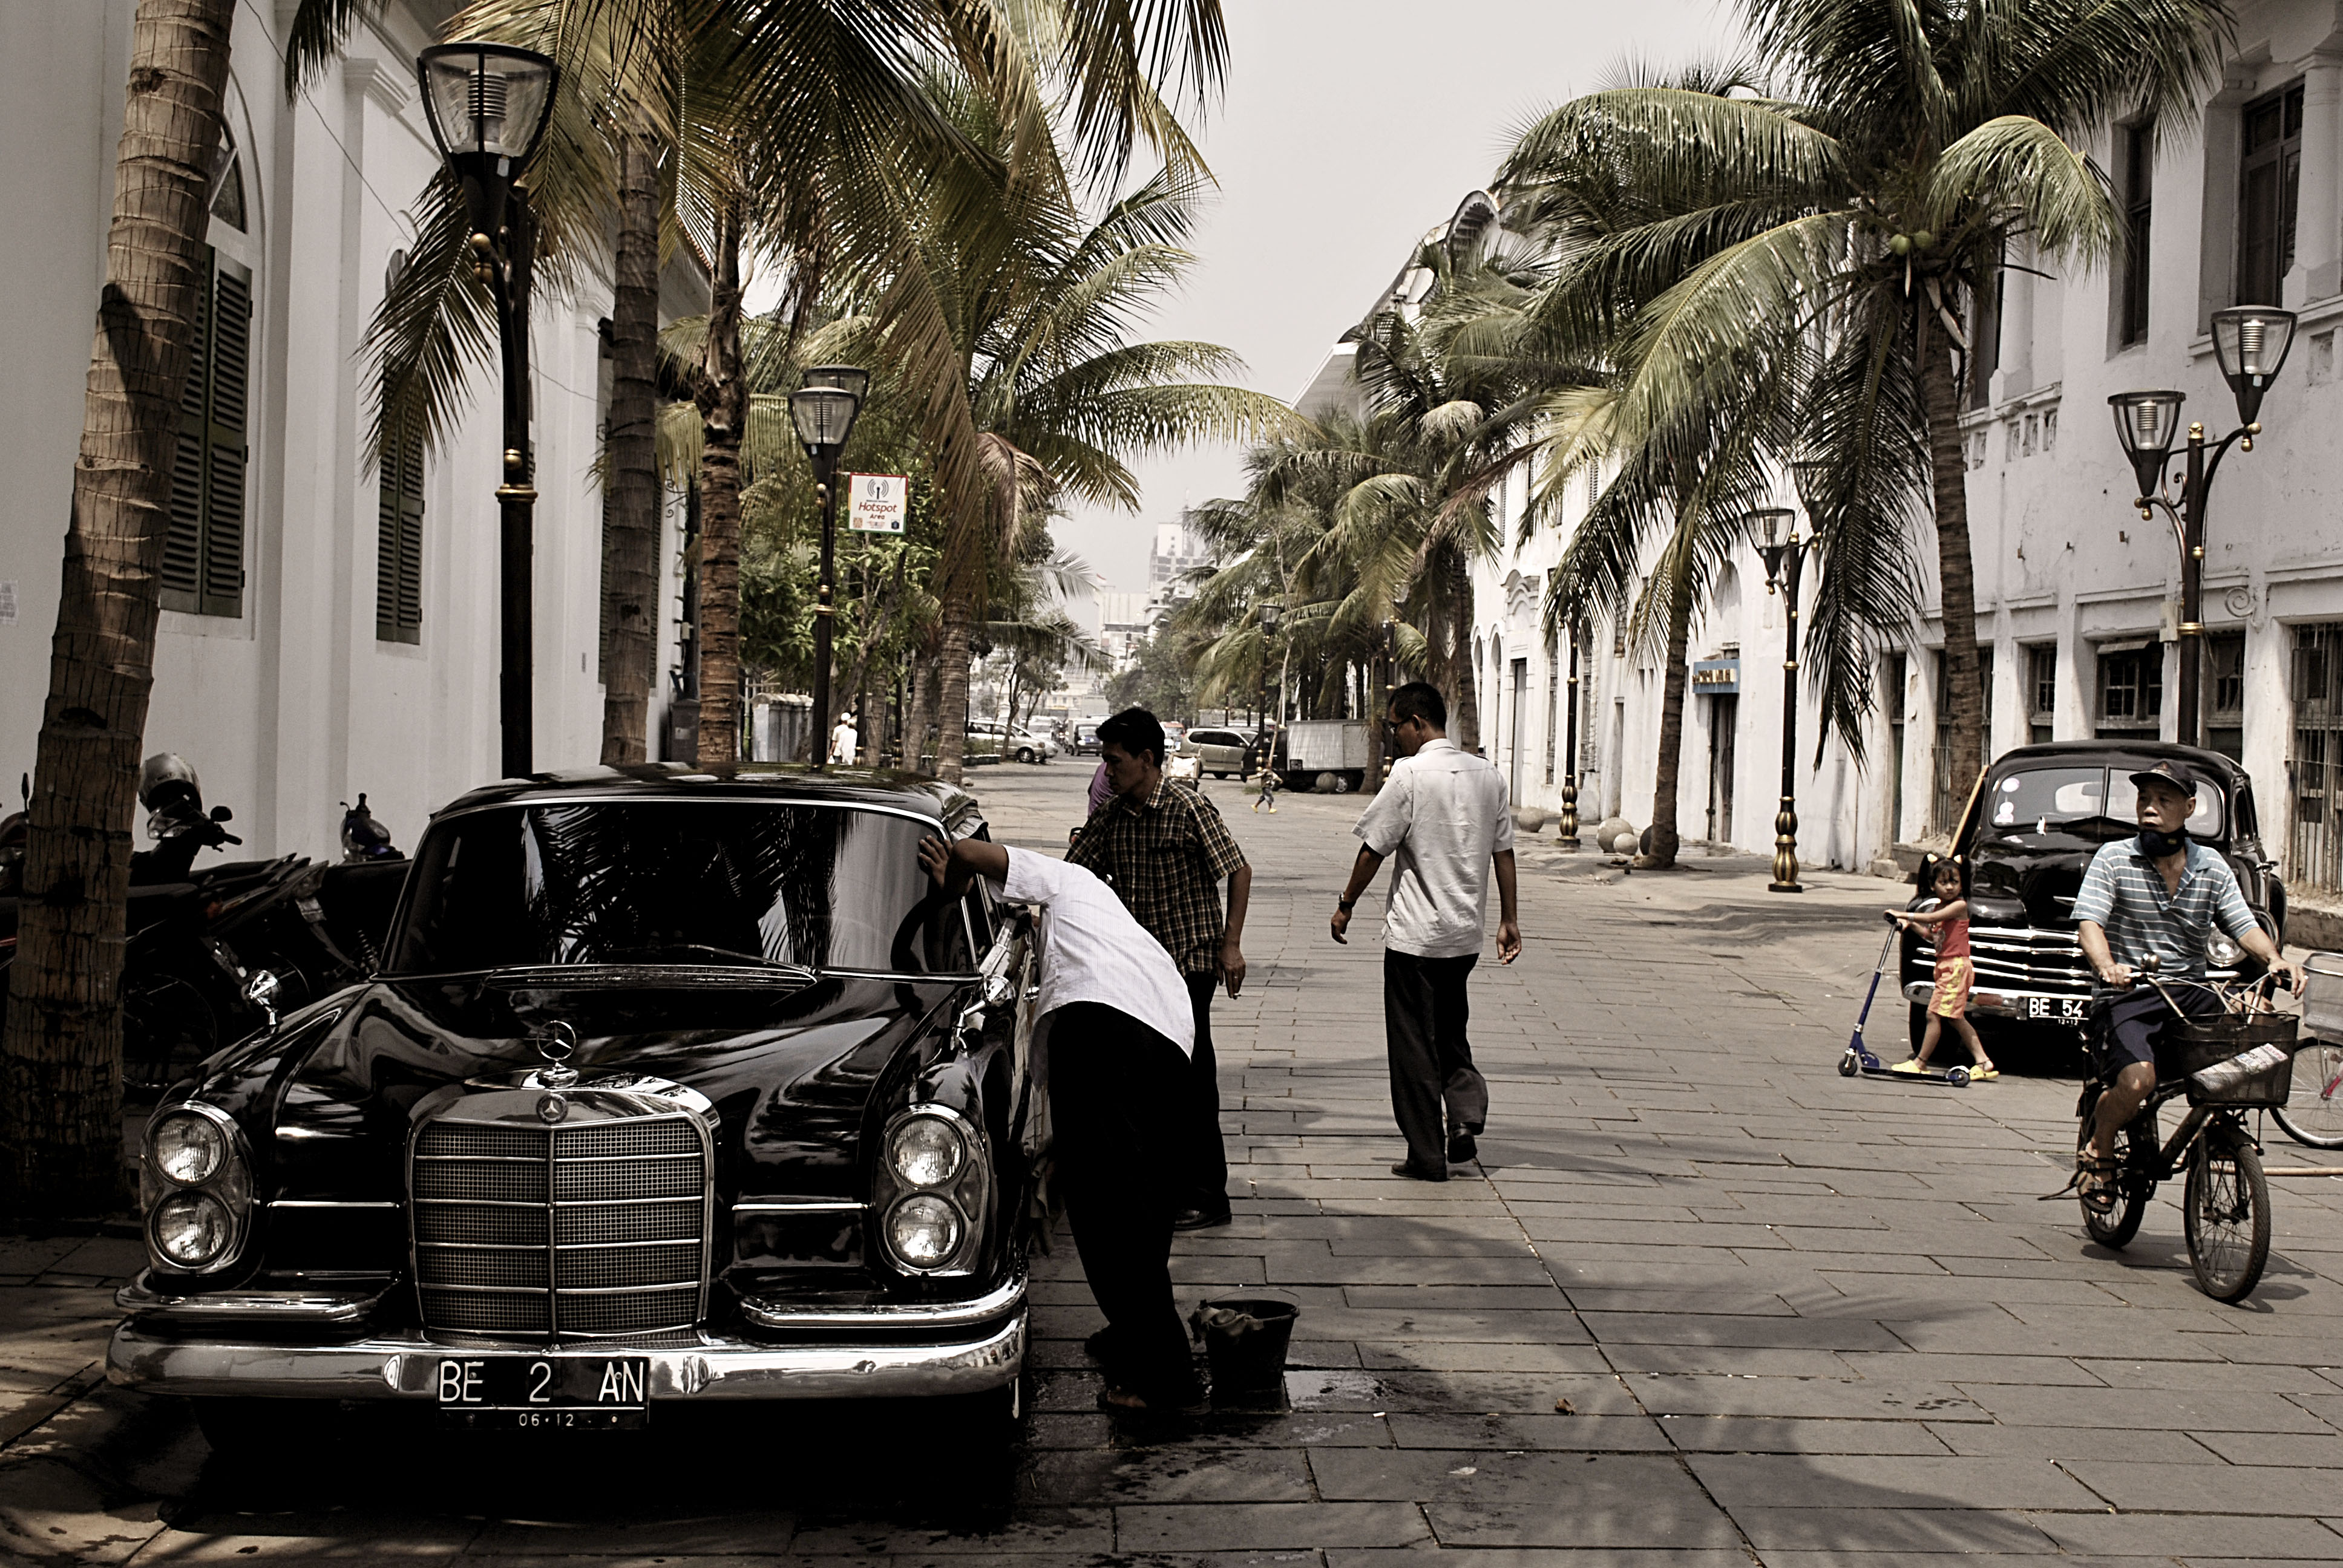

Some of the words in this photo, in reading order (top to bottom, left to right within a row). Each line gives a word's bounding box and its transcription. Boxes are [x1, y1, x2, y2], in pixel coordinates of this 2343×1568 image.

[859, 502, 897, 514] Hotspot
[2029, 998, 2050, 1016] BE
[2062, 999, 2083, 1018] 54
[439, 1360, 484, 1402] BE
[528, 1361, 551, 1402] 2
[598, 1361, 644, 1402] AN
